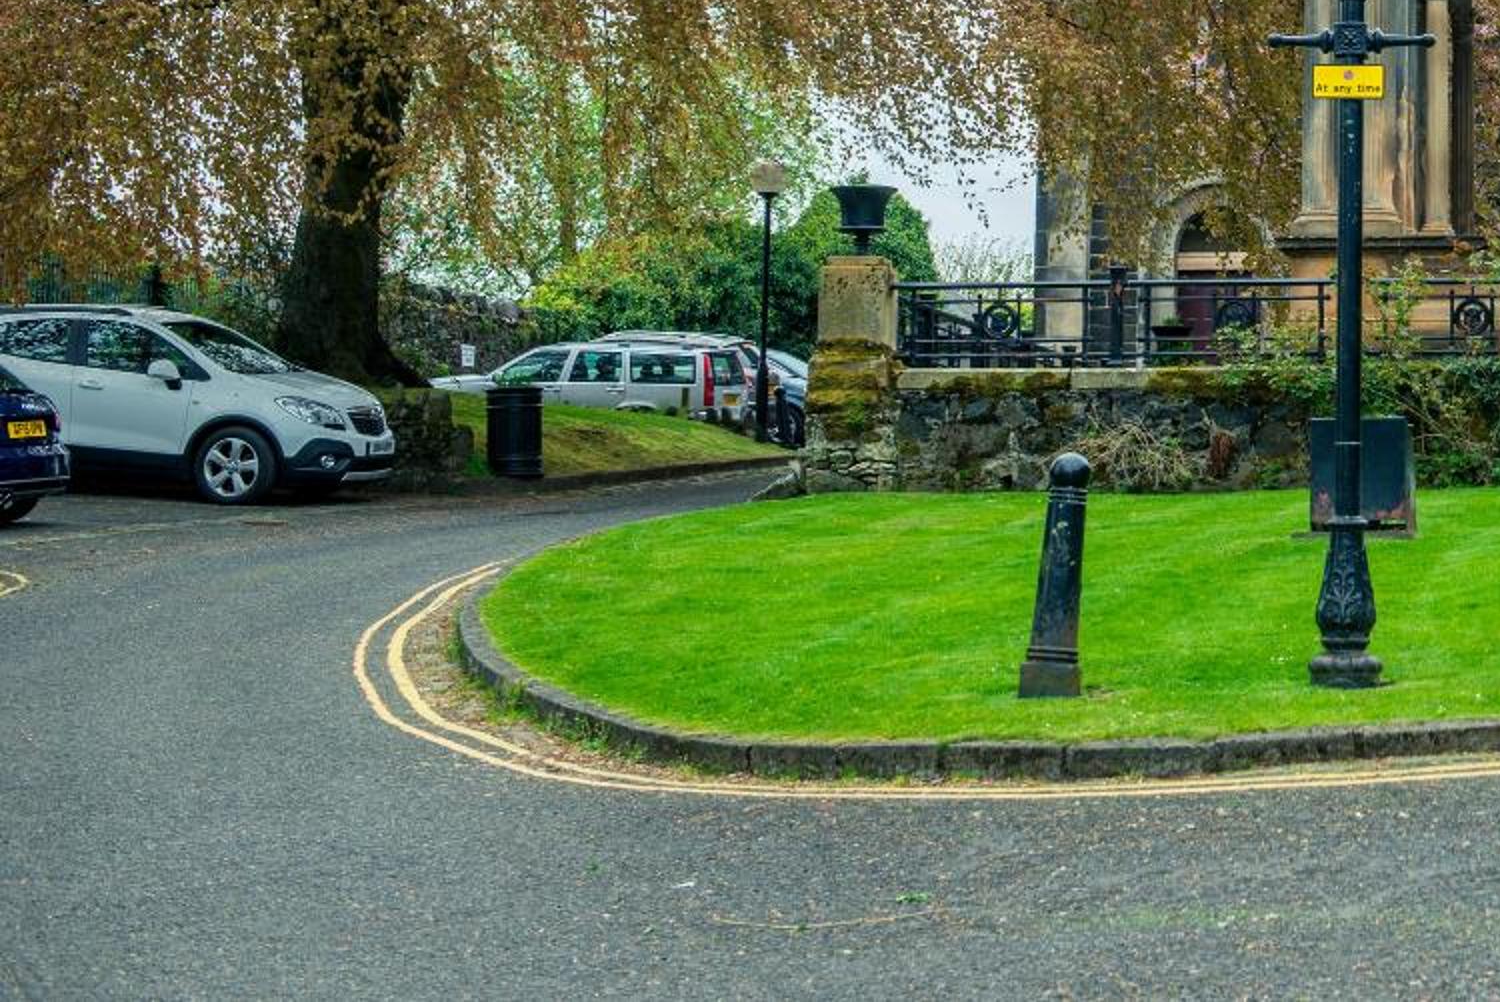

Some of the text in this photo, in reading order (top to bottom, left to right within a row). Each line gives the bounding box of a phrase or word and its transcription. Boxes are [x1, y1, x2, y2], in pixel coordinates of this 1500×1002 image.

[1316, 83, 1381, 94] At any time
